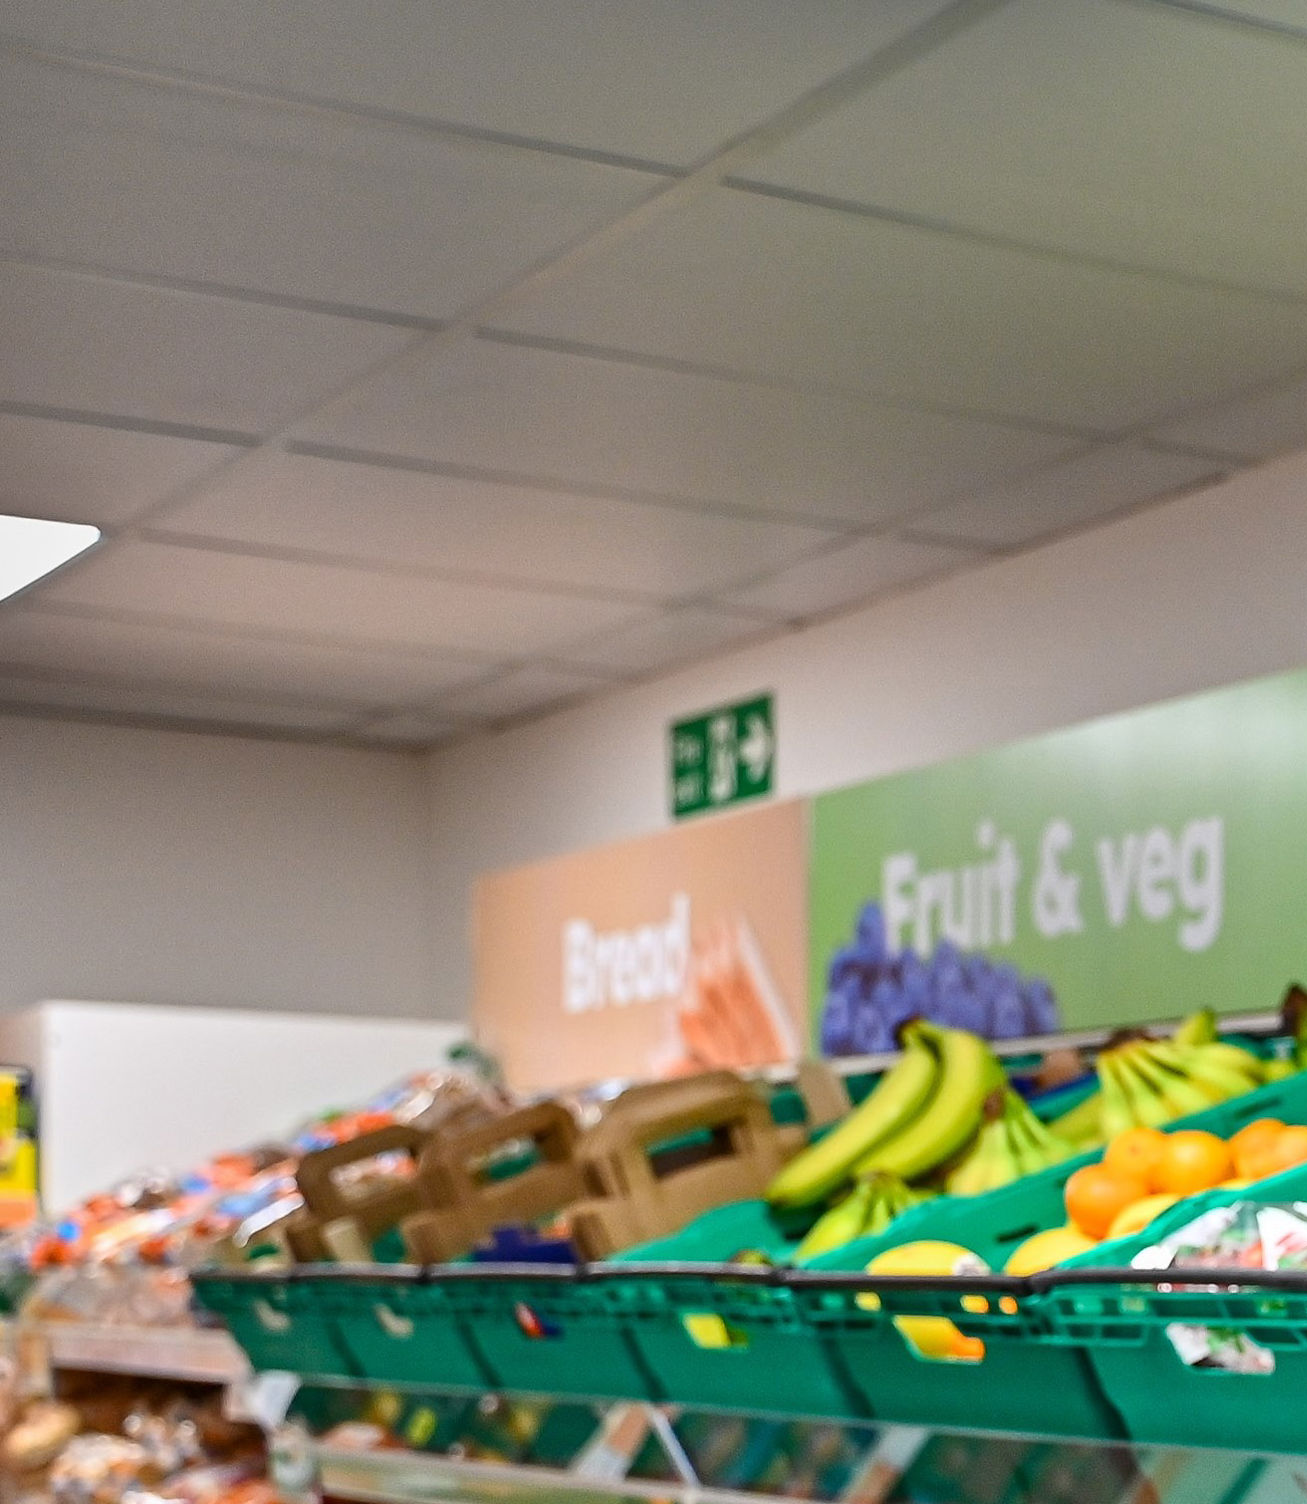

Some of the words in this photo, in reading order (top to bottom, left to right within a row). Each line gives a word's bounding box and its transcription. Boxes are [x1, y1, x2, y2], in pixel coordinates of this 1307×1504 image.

[562, 893, 691, 1012] Bread
[883, 821, 1020, 961] Fruit
[1033, 819, 1082, 936] &
[1098, 819, 1225, 950] veg
